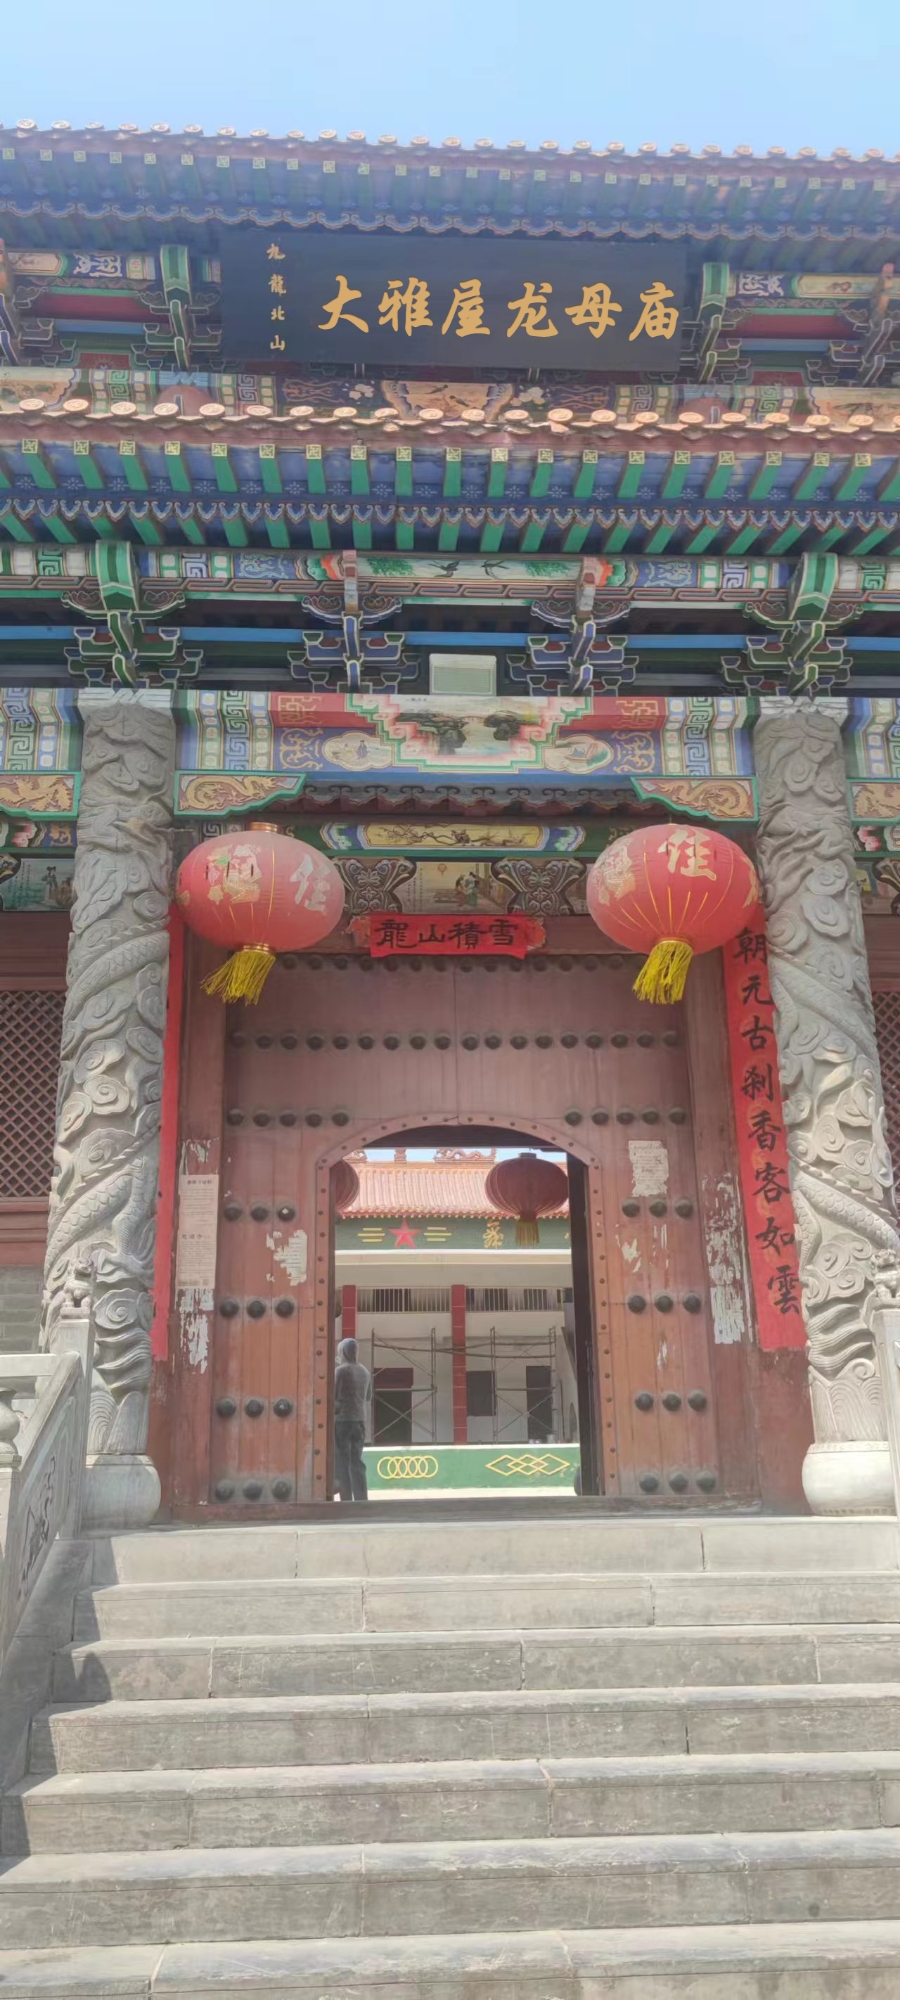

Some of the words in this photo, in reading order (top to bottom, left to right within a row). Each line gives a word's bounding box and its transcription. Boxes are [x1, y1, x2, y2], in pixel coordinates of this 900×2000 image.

[266, 243, 287, 351] 九龍北山
[317, 274, 680, 341] 大雅屋龙母庙
[374, 918, 519, 950] 龍山積雪
